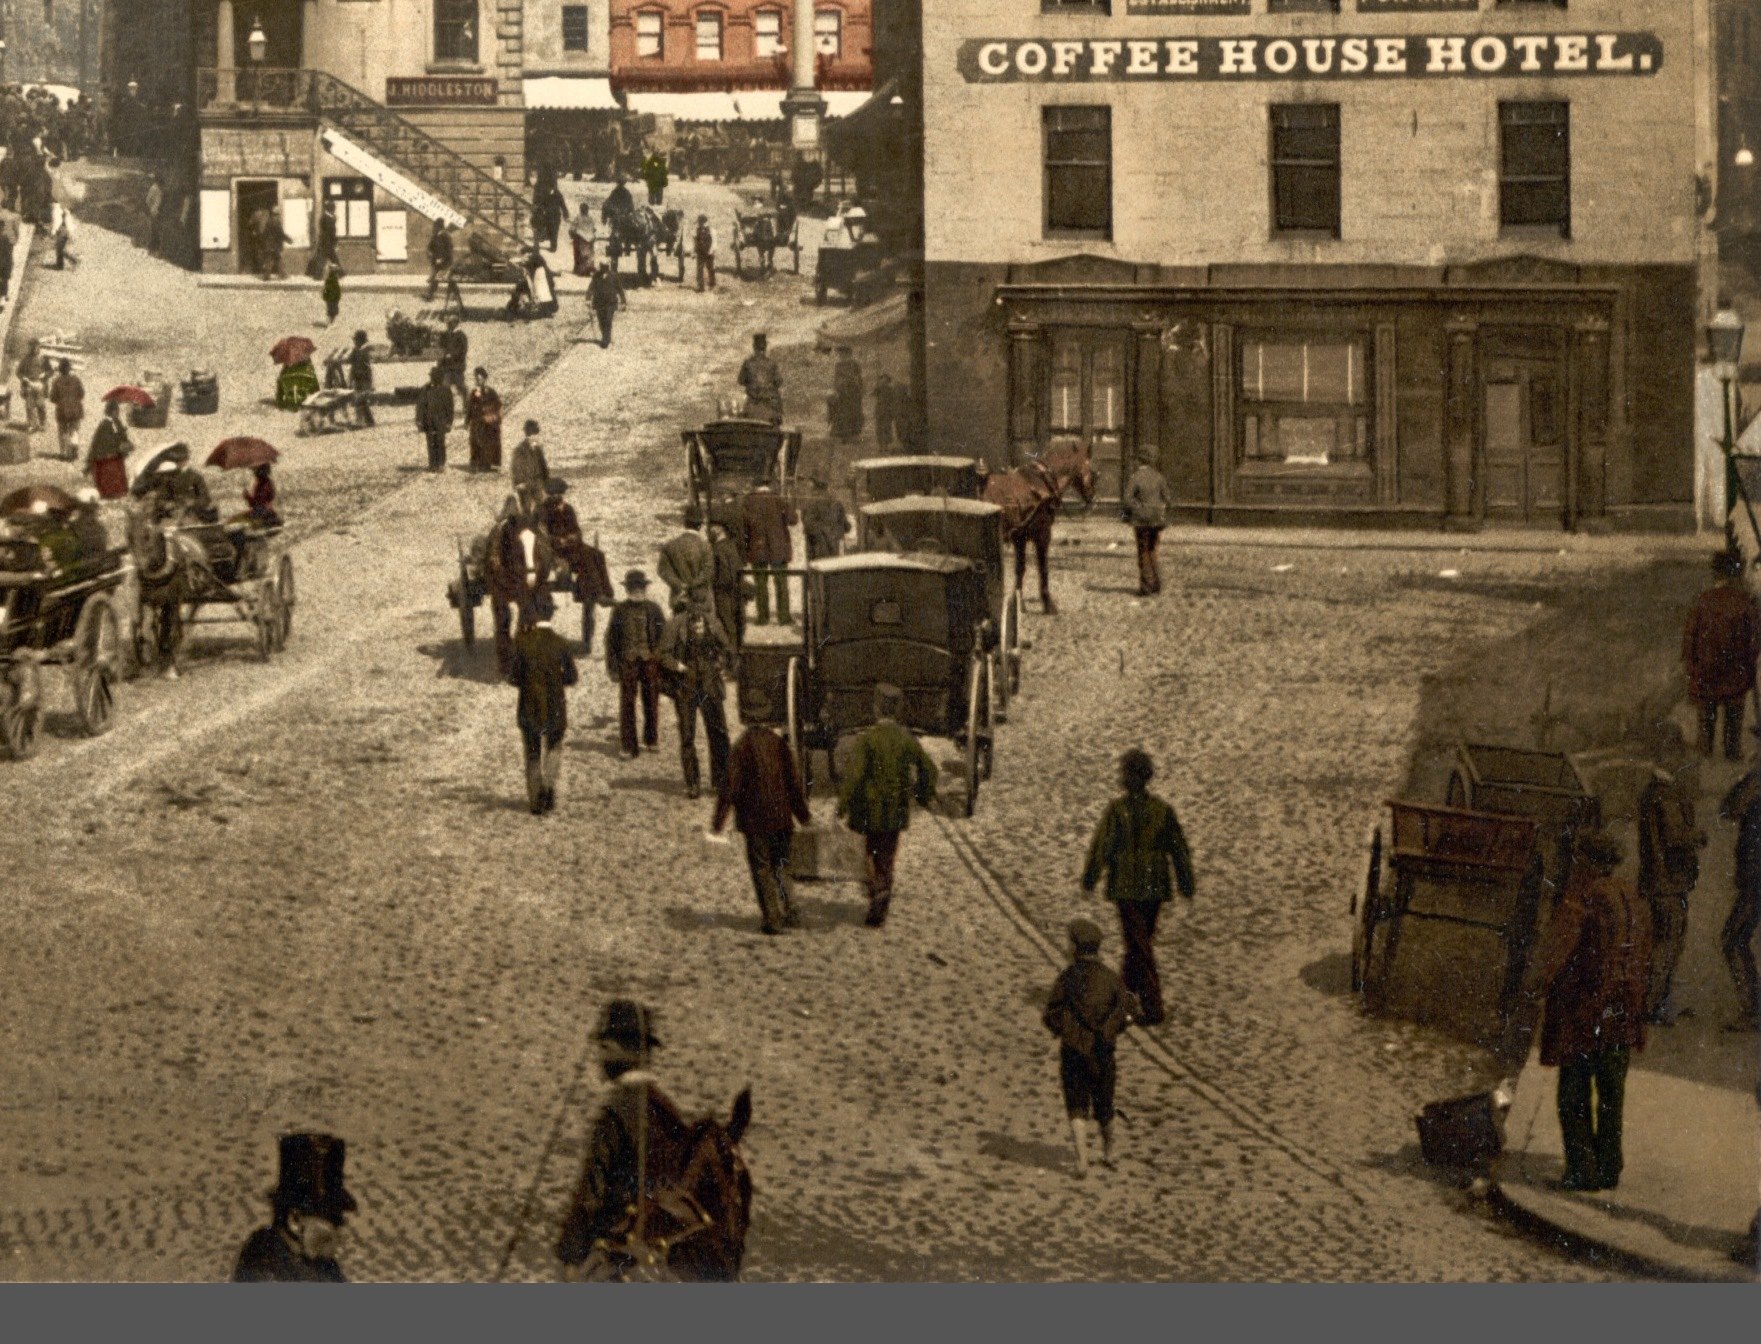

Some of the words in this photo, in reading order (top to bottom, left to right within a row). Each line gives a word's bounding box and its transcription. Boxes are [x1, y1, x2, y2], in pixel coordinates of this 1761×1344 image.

[979, 40, 1199, 75] COFFEE
[1219, 38, 1408, 74] HOUSE
[1425, 33, 1653, 73] HOTEL.
